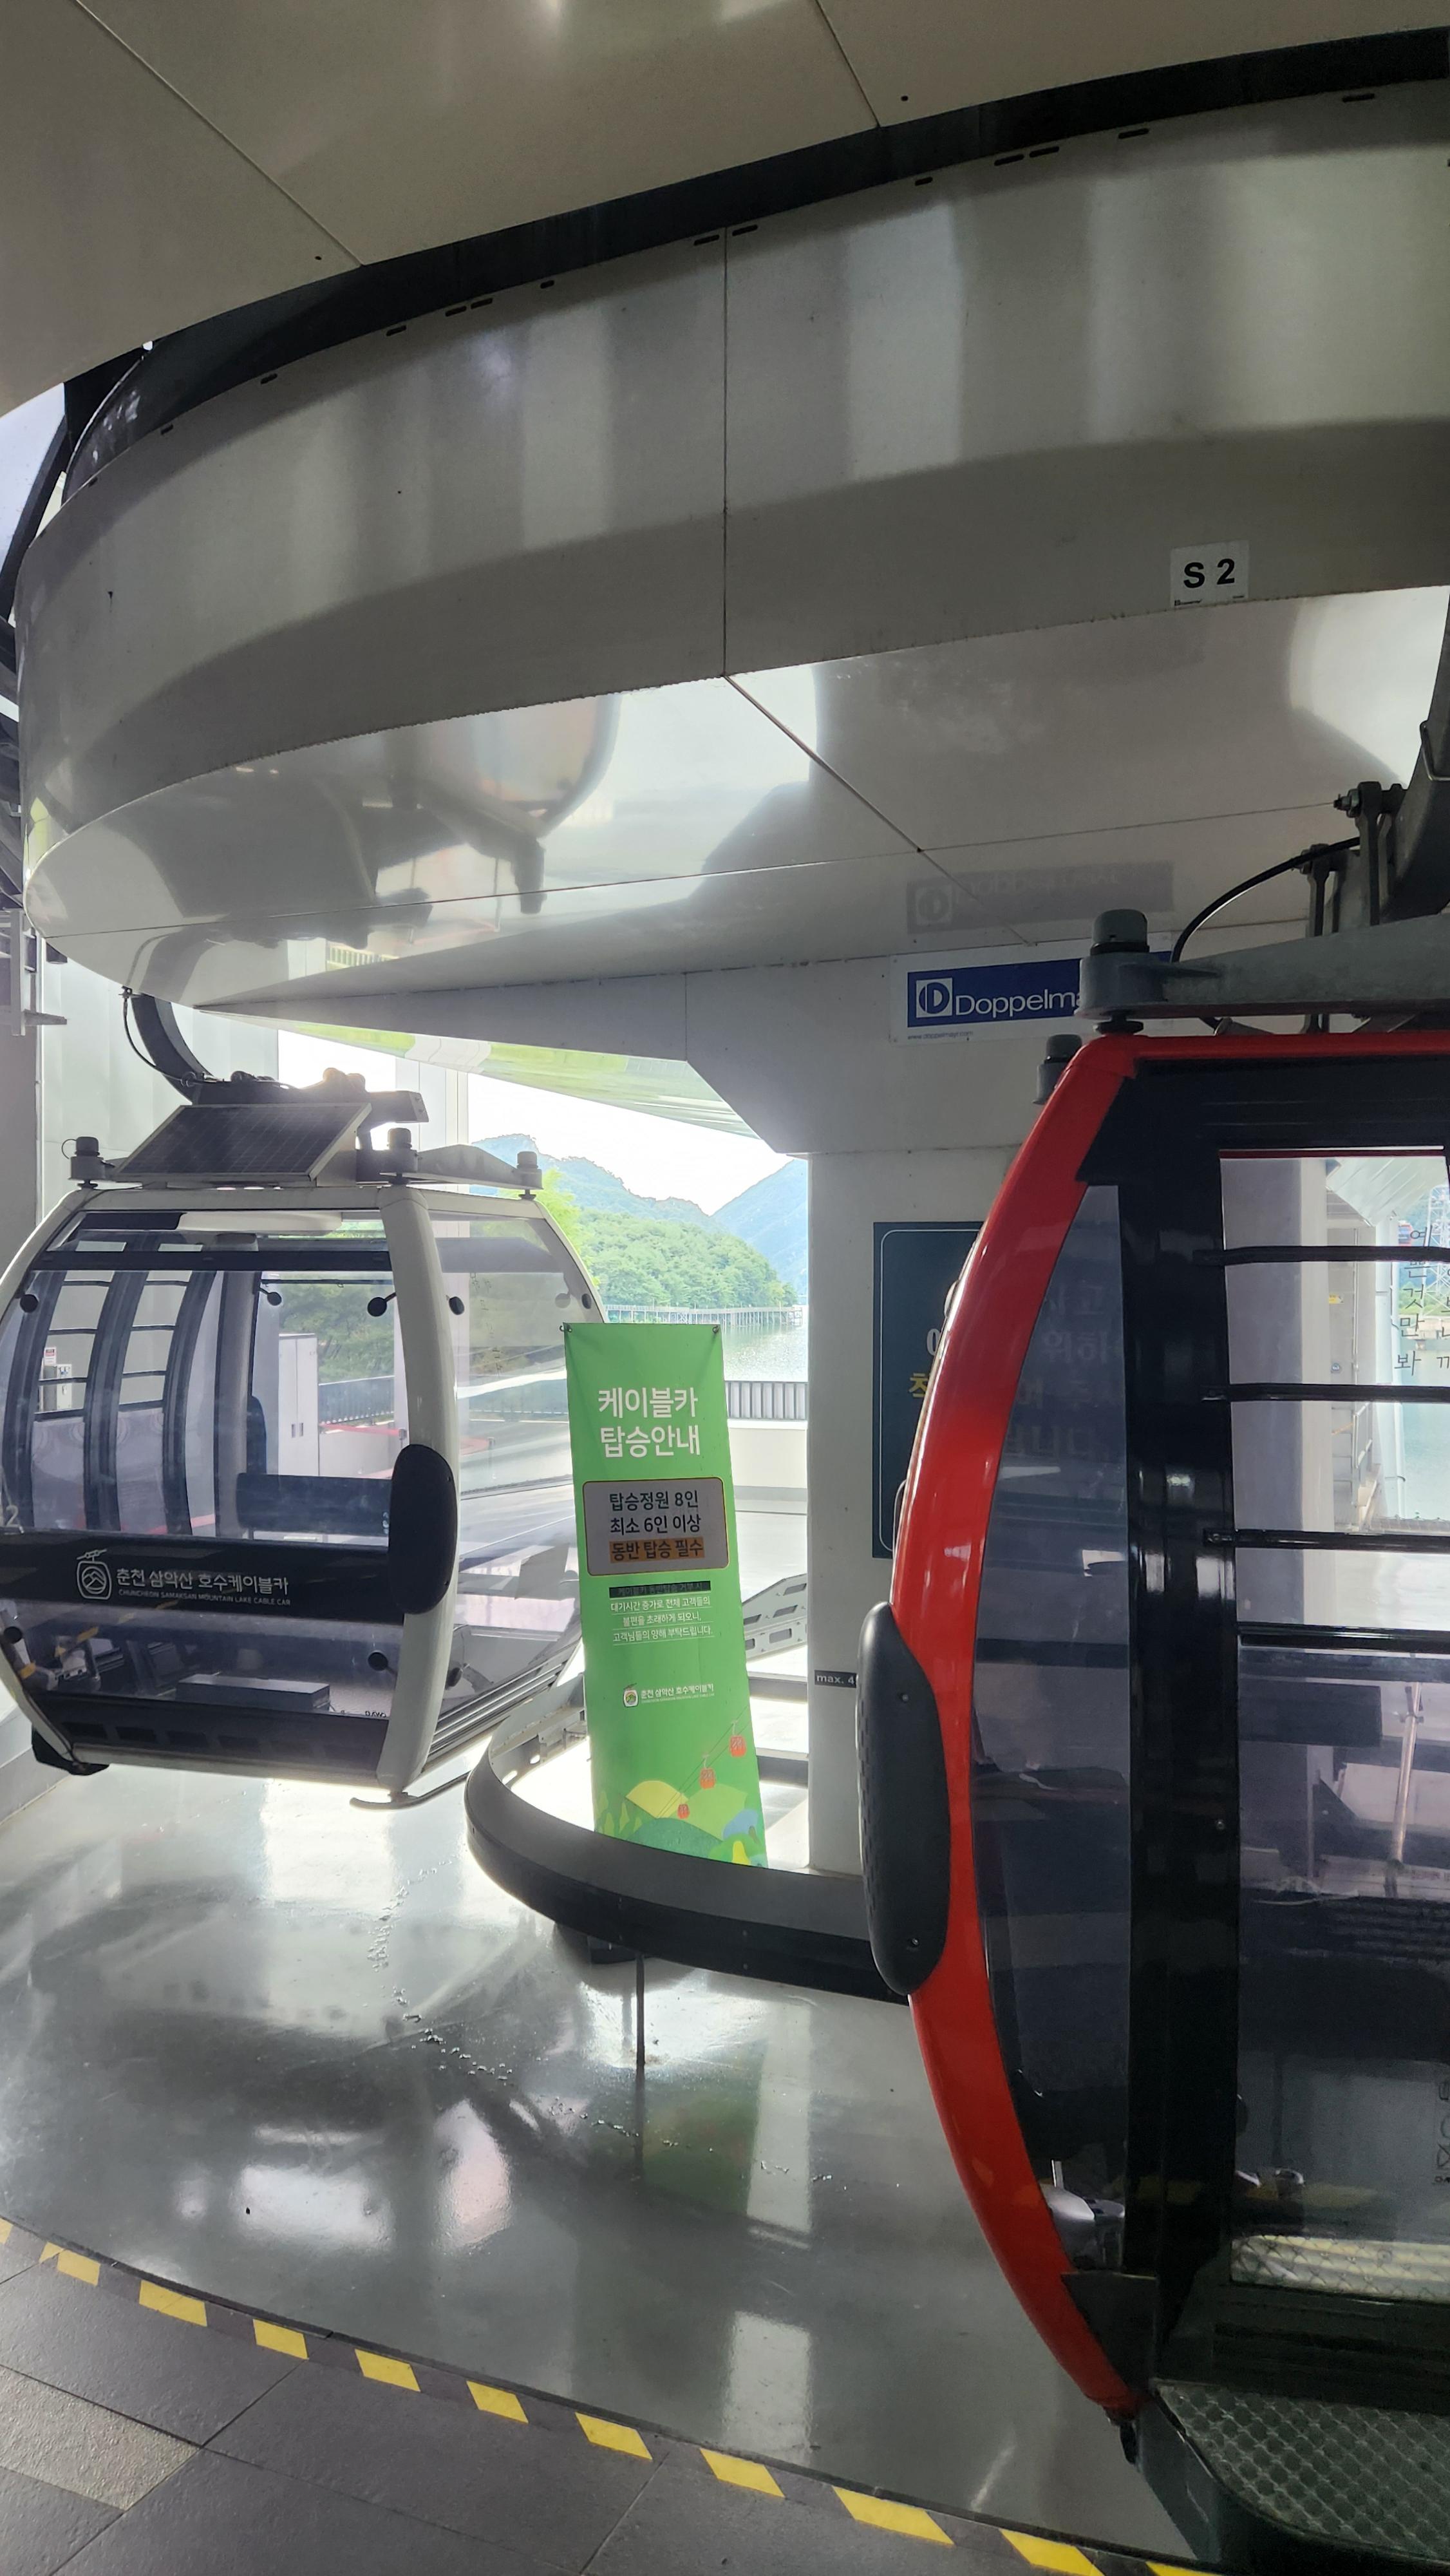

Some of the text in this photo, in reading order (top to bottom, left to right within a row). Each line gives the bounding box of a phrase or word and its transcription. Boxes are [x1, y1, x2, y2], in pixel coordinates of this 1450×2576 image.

[1183, 558, 1236, 589] S 2
[956, 989, 1080, 1018] Doppelm
[598, 1387, 698, 1418] 케이블카
[601, 1424, 701, 1458] 탑승안내
[609, 1490, 700, 1511] 탑승정원 8인
[610, 1513, 701, 1535] 최소 6인 이상
[611, 1539, 704, 1560] 동반 탑승 필수
[117, 1568, 289, 1595] 춘천 삼악산 호수케이블카
[611, 1596, 711, 1613] 대기시간 증가로 전체 고객들의
[623, 1615, 645, 1627] 불편을
[646, 1613, 676, 1624] 초래하게
[613, 1630, 650, 1642] 고객님들의
[816, 1674, 844, 1685] max.
